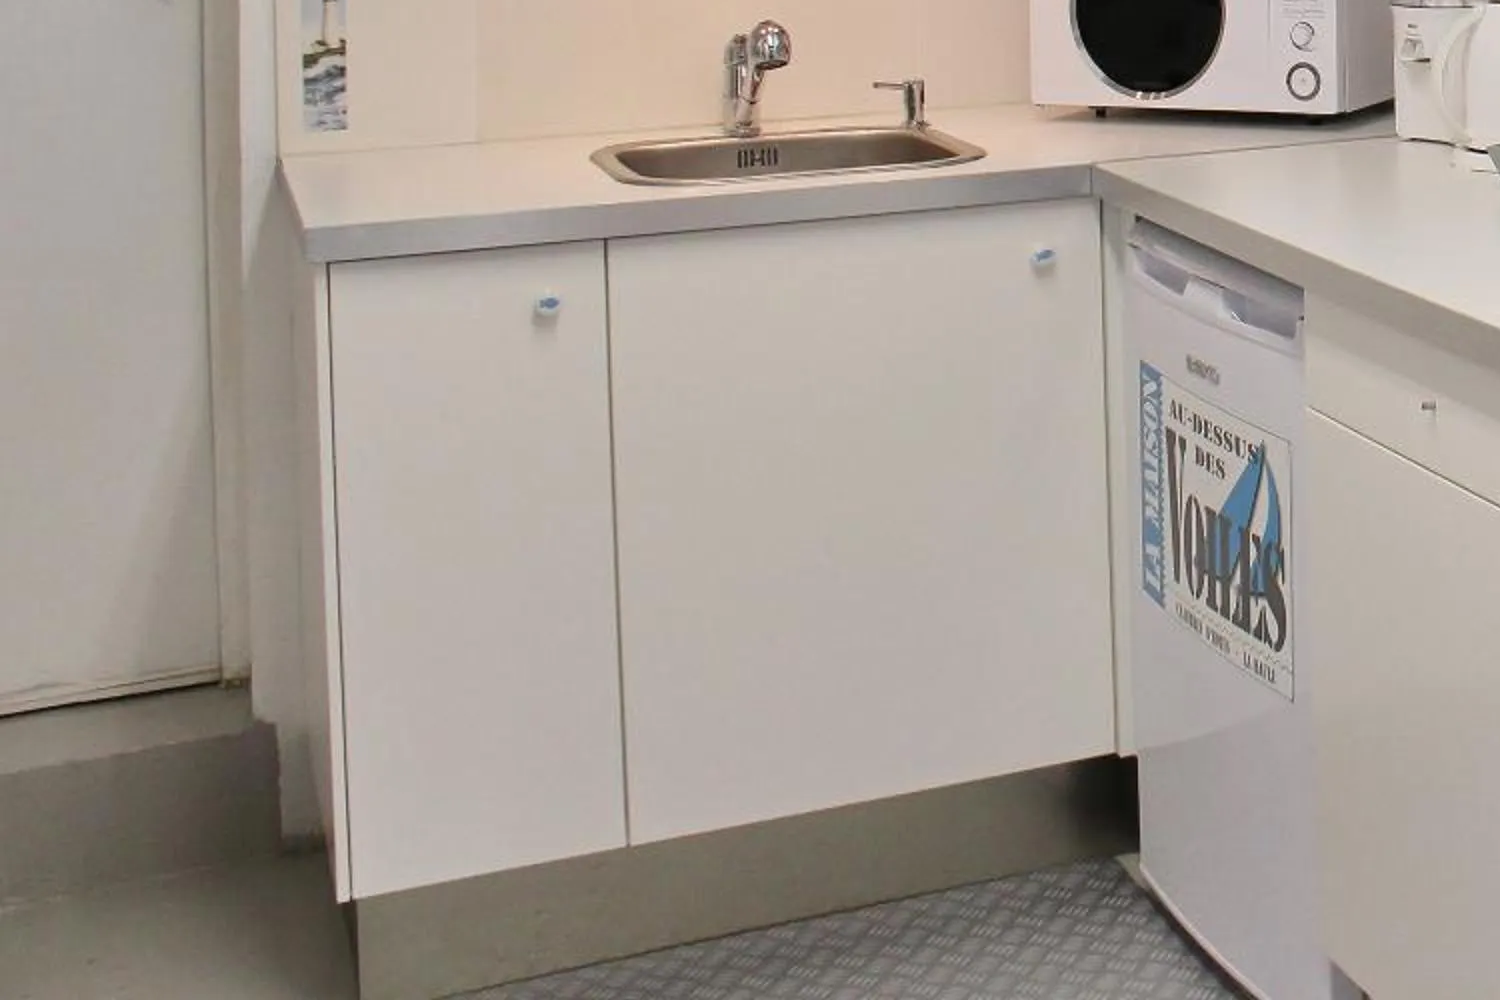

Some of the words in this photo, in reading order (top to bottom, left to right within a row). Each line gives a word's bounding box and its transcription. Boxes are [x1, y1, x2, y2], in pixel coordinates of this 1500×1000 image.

[1142, 373, 1162, 529] MAISON
[1169, 400, 1258, 463] AU-DESSUS
[1195, 445, 1226, 480] DES
[1144, 544, 1162, 592] LA
[1165, 427, 1286, 653] VOILES
